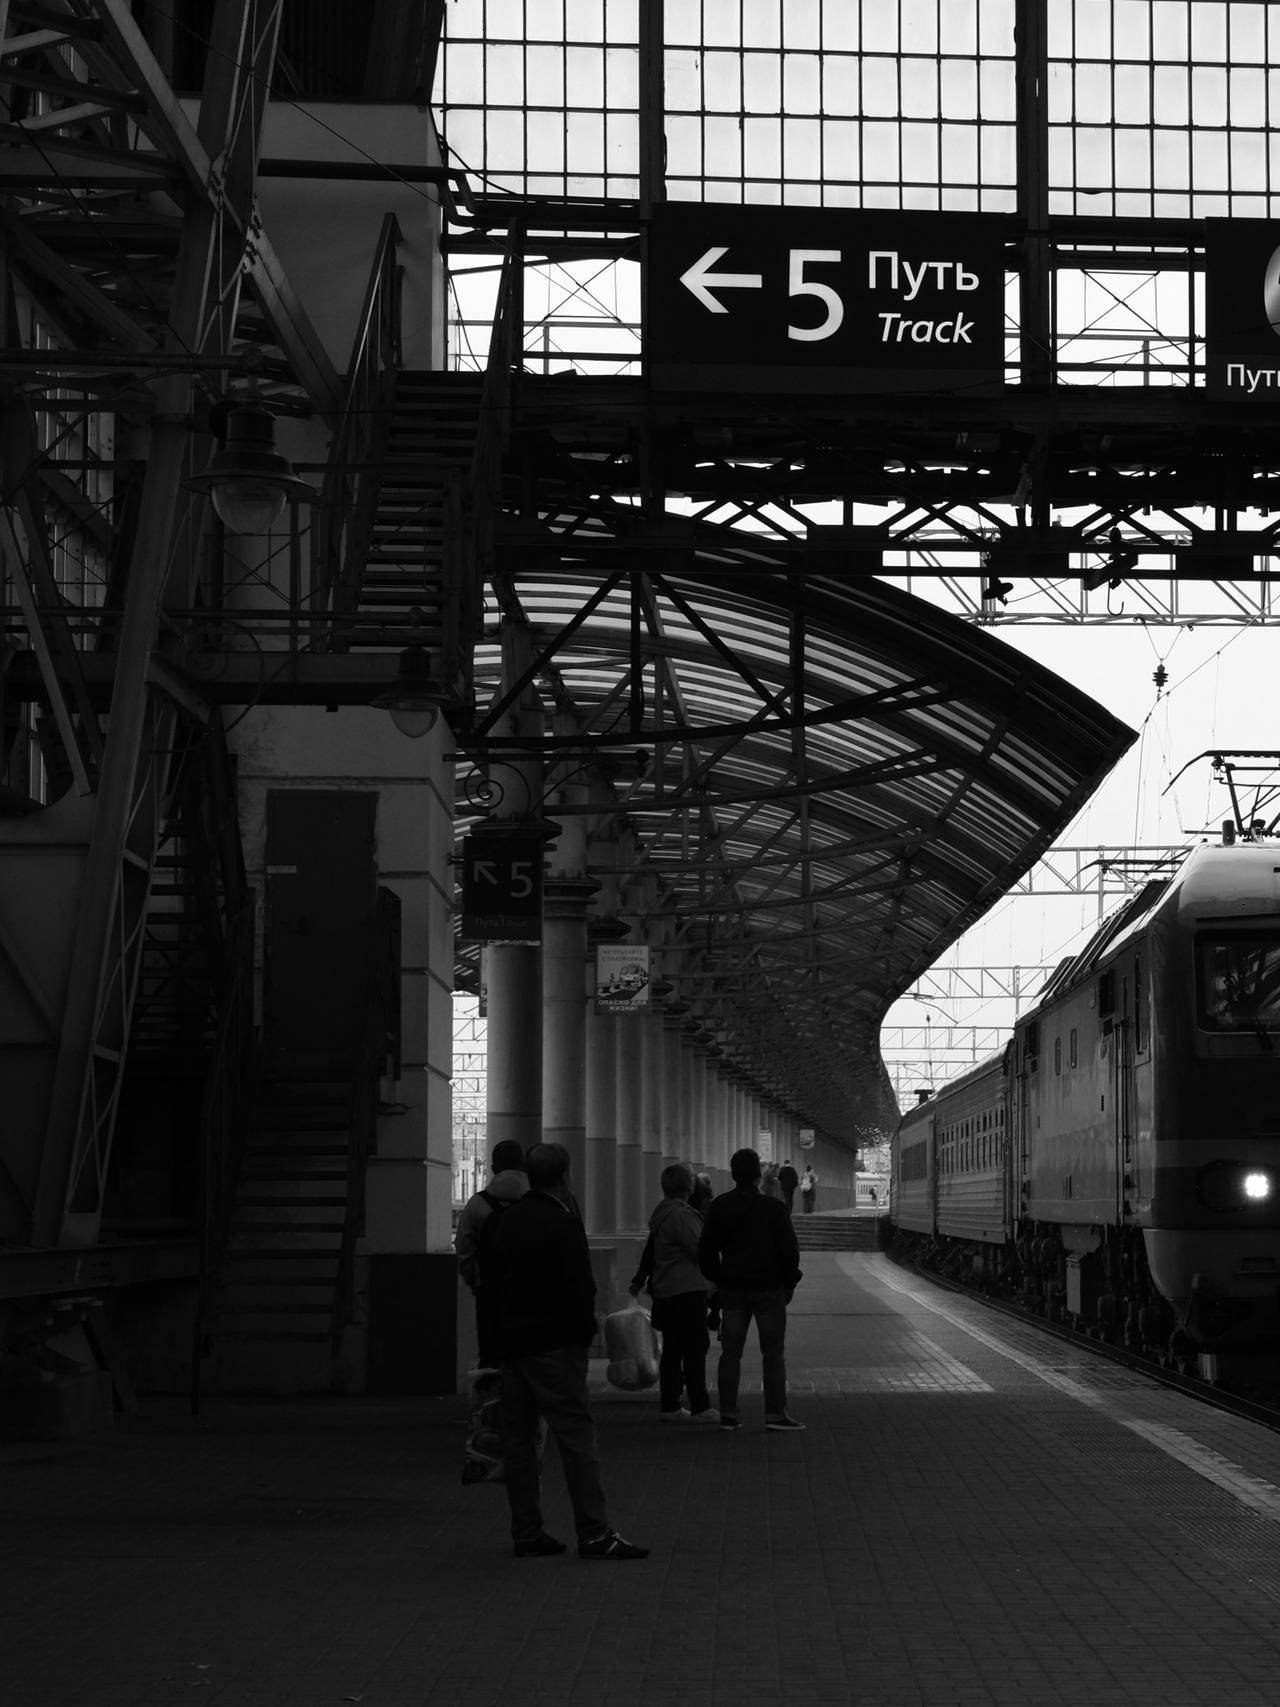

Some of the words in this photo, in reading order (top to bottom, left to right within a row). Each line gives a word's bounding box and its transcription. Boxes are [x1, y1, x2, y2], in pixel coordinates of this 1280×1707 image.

[868, 250, 980, 301] Путь
[787, 248, 844, 342] 5
[878, 311, 975, 344] Track
[509, 861, 534, 899] 5
[475, 917, 500, 929] Путь
